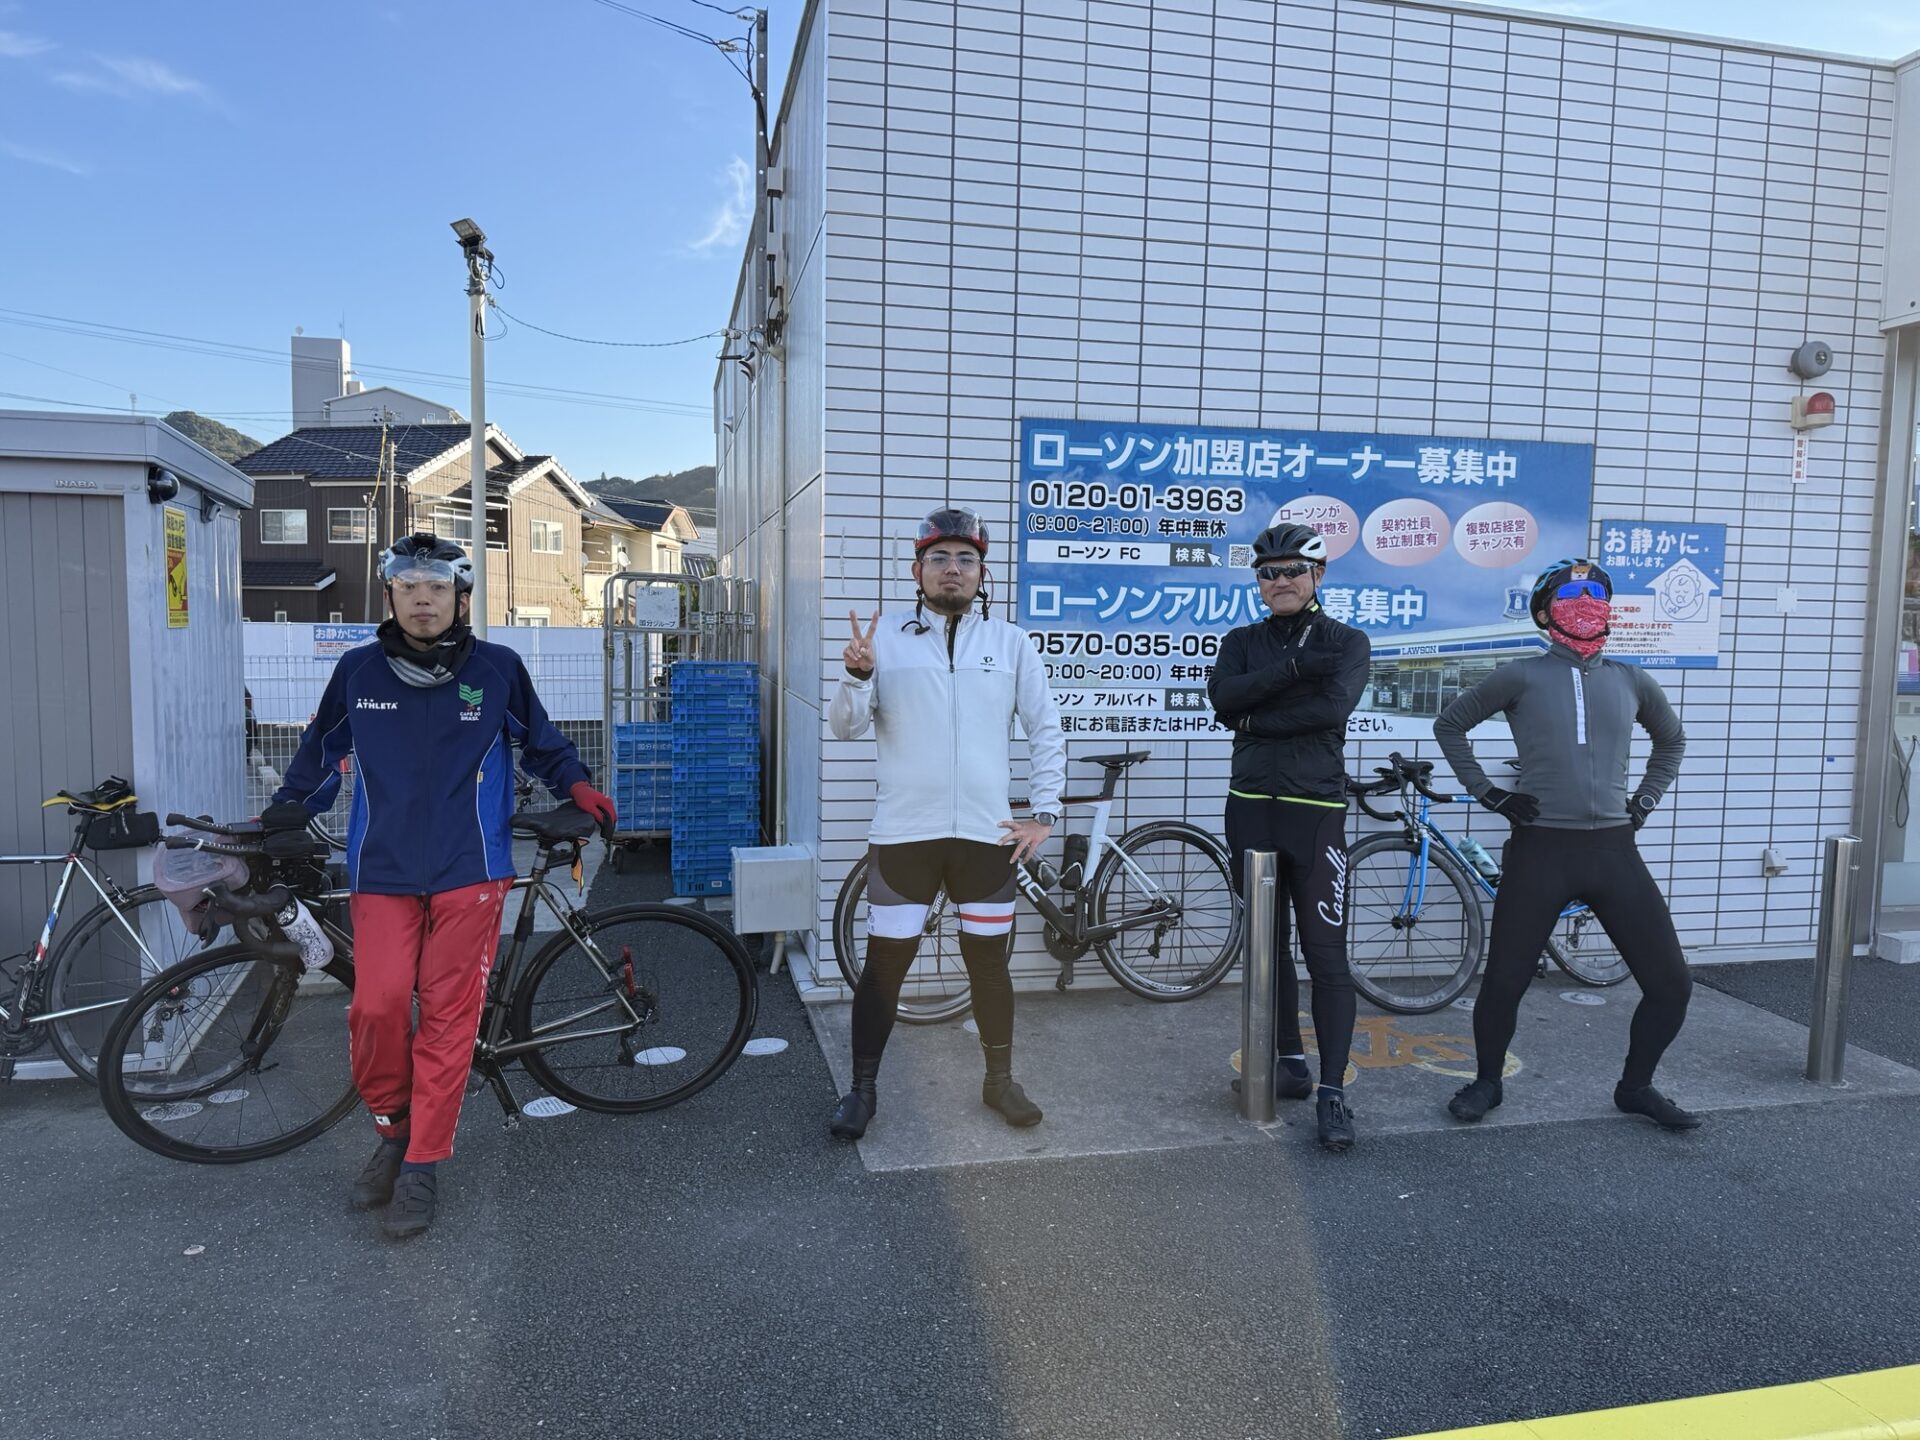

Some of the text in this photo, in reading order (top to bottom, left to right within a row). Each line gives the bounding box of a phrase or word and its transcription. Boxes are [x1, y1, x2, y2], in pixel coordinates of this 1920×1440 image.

[1033, 433, 1517, 486] ローソン加盟店オーナー募集中
[55, 480, 97, 489] INABA
[1030, 482, 1244, 513] 0120-01-3963
[1280, 505, 1341, 520] ローソンが
[1158, 518, 1227, 538] 年中無休
[1381, 516, 1431, 531] 契約社員
[1466, 520, 1526, 535] 複数店経営
[1376, 532, 1438, 549] 独立制度有
[1468, 535, 1525, 550] チャンス有
[1604, 527, 1700, 555] お静かに
[1057, 546, 1141, 560] ローソン FC
[1175, 547, 1206, 563] 検索
[1605, 555, 1666, 569] お願いします。
[315, 627, 357, 640] お静かに
[1029, 632, 1226, 657] 0570-035-06
[1402, 645, 1437, 655] LAWSON
[1640, 657, 1677, 665] LAWSON
[356, 700, 397, 710] ATHLETA
[1094, 693, 1158, 707] アルバイト
[1170, 692, 1200, 707] 検索
[1317, 845, 1348, 927] Castelli
